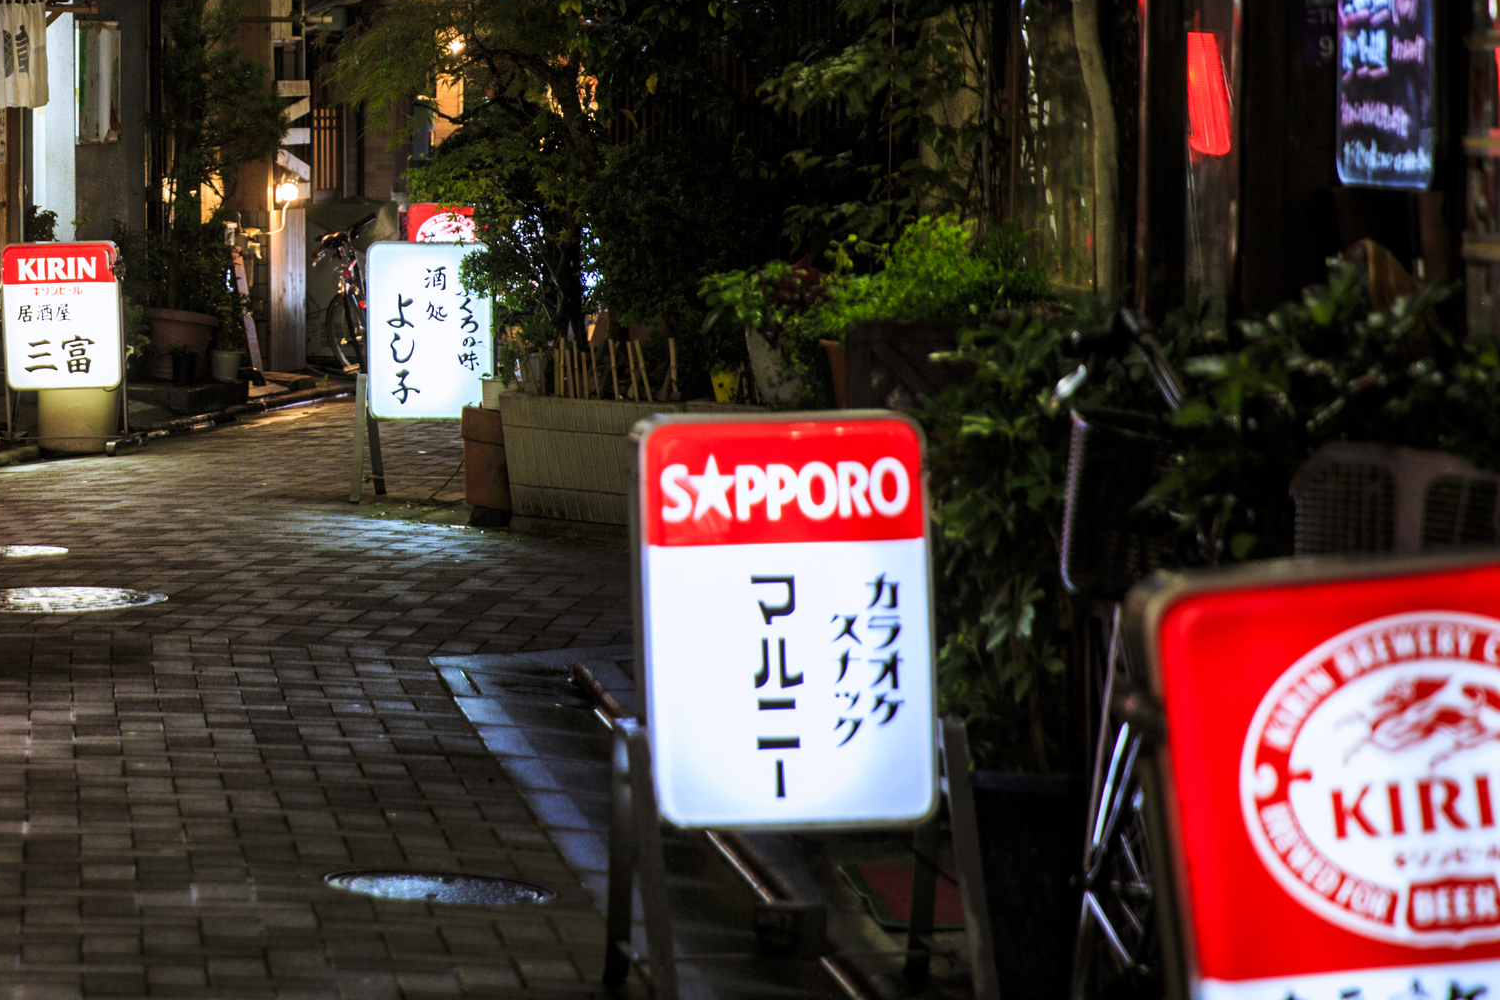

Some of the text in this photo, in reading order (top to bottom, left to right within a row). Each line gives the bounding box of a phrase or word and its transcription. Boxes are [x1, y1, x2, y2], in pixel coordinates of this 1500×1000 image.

[17, 256, 97, 282] KIRIN
[424, 265, 448, 322] 酒処
[17, 303, 72, 323] 居酒屋
[24, 334, 96, 375] 三富
[386, 292, 421, 405] よし子
[829, 611, 863, 749] スナック
[864, 571, 905, 728] カラオケ
[1332, 623, 1474, 677] BREWERY
[749, 574, 805, 799] マルニー
[1331, 774, 1498, 840] KIRI
